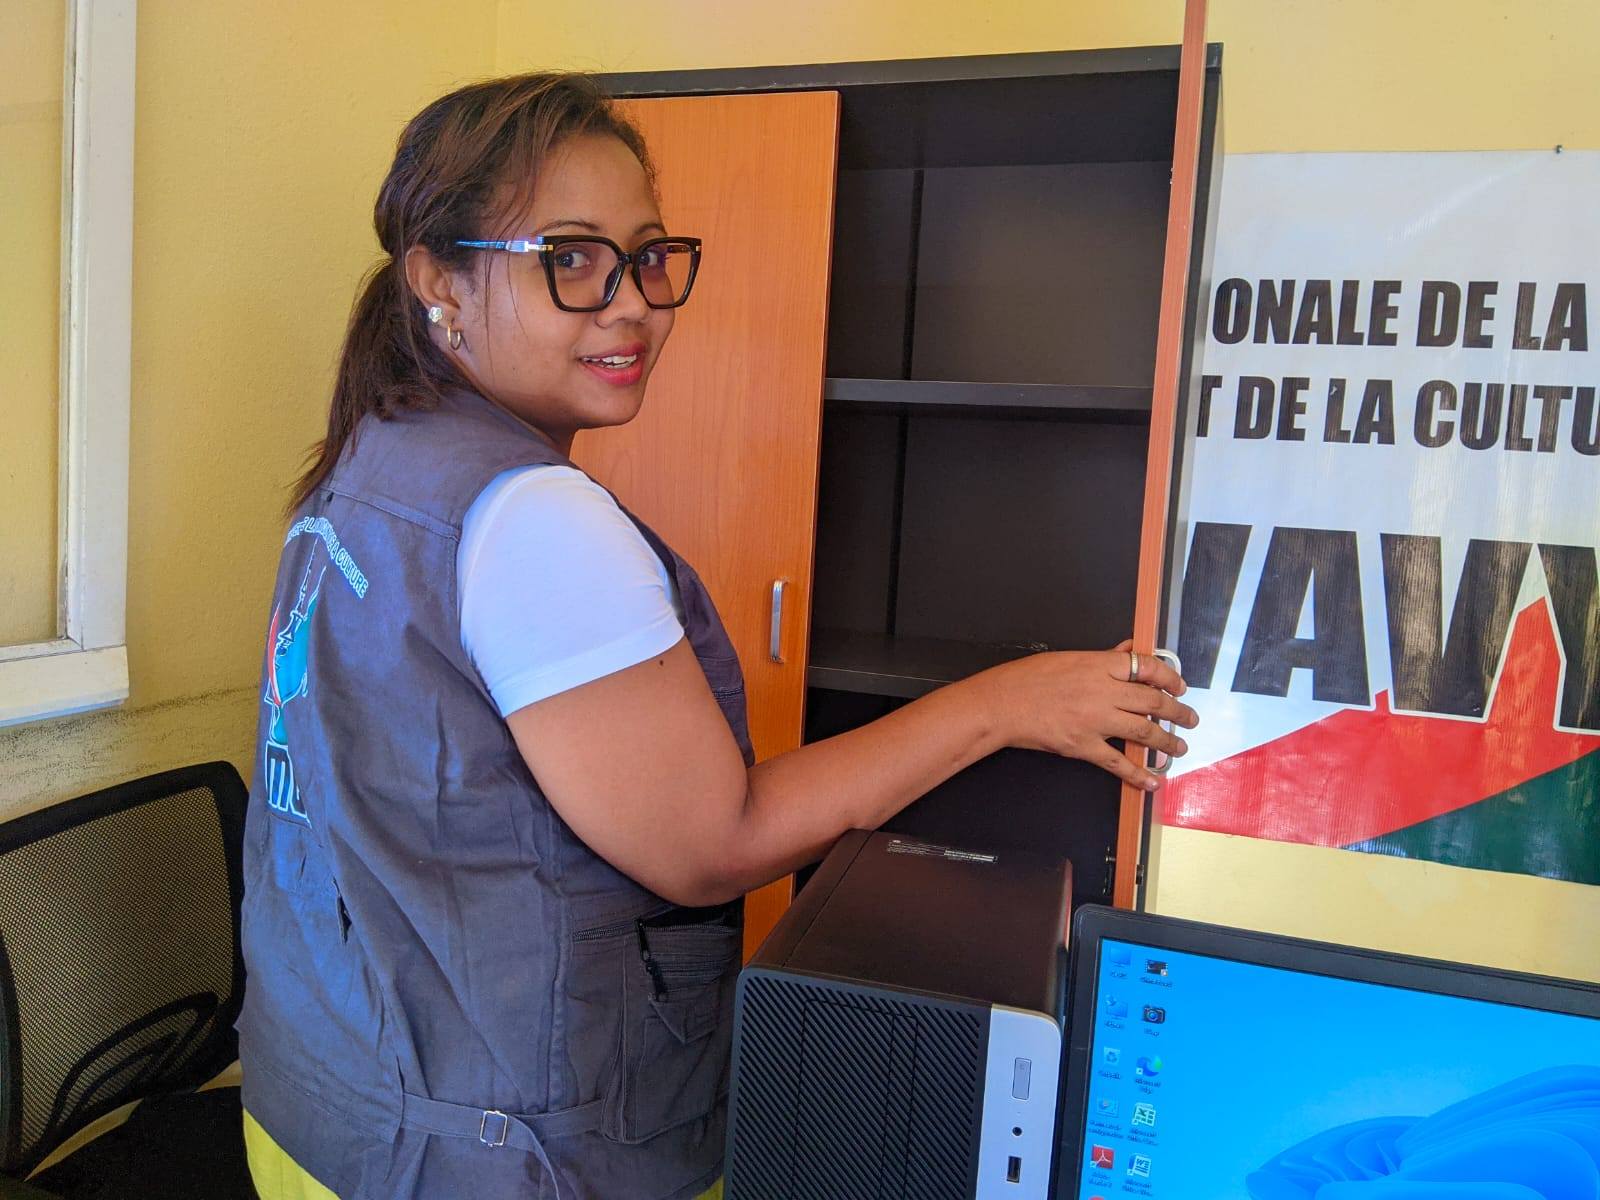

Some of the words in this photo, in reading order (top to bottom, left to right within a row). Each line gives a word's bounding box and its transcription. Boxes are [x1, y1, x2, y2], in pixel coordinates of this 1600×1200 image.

[1212, 277, 1402, 346] ONALE
[1416, 280, 1499, 349] DE
[1512, 281, 1589, 352] LA
[1233, 375, 1310, 442] DE
[1323, 377, 1396, 446] LA
[1413, 379, 1600, 456] CULTU
[335, 547, 368, 599] CULTURE
